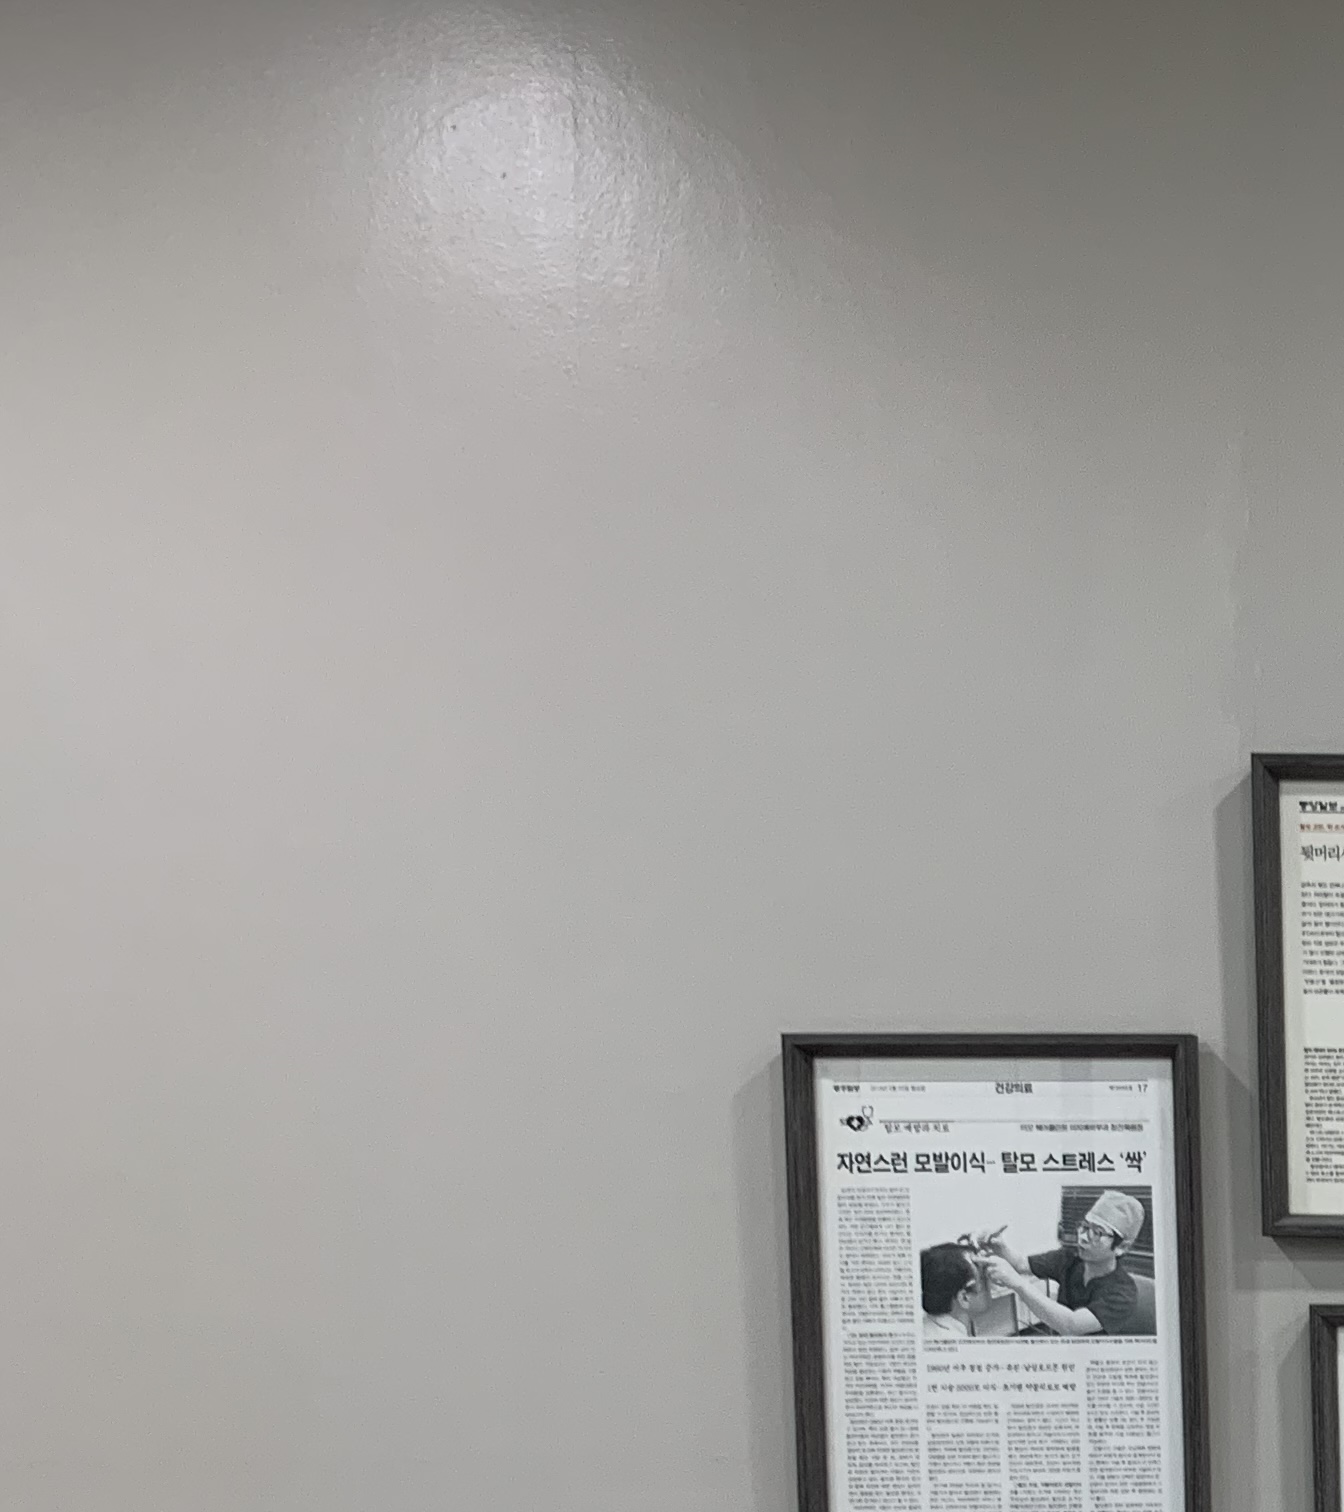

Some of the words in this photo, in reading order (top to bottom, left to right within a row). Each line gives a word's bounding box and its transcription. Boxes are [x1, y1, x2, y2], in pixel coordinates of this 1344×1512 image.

[994, 1082, 1034, 1094] 건강의료
[1137, 1084, 1148, 1092] 17
[837, 1152, 907, 1173] 자연스런
[1001, 1152, 1037, 1173] 탈모
[1043, 1152, 1115, 1172] 스트레스
[1120, 1151, 1146, 1173] '싹'
